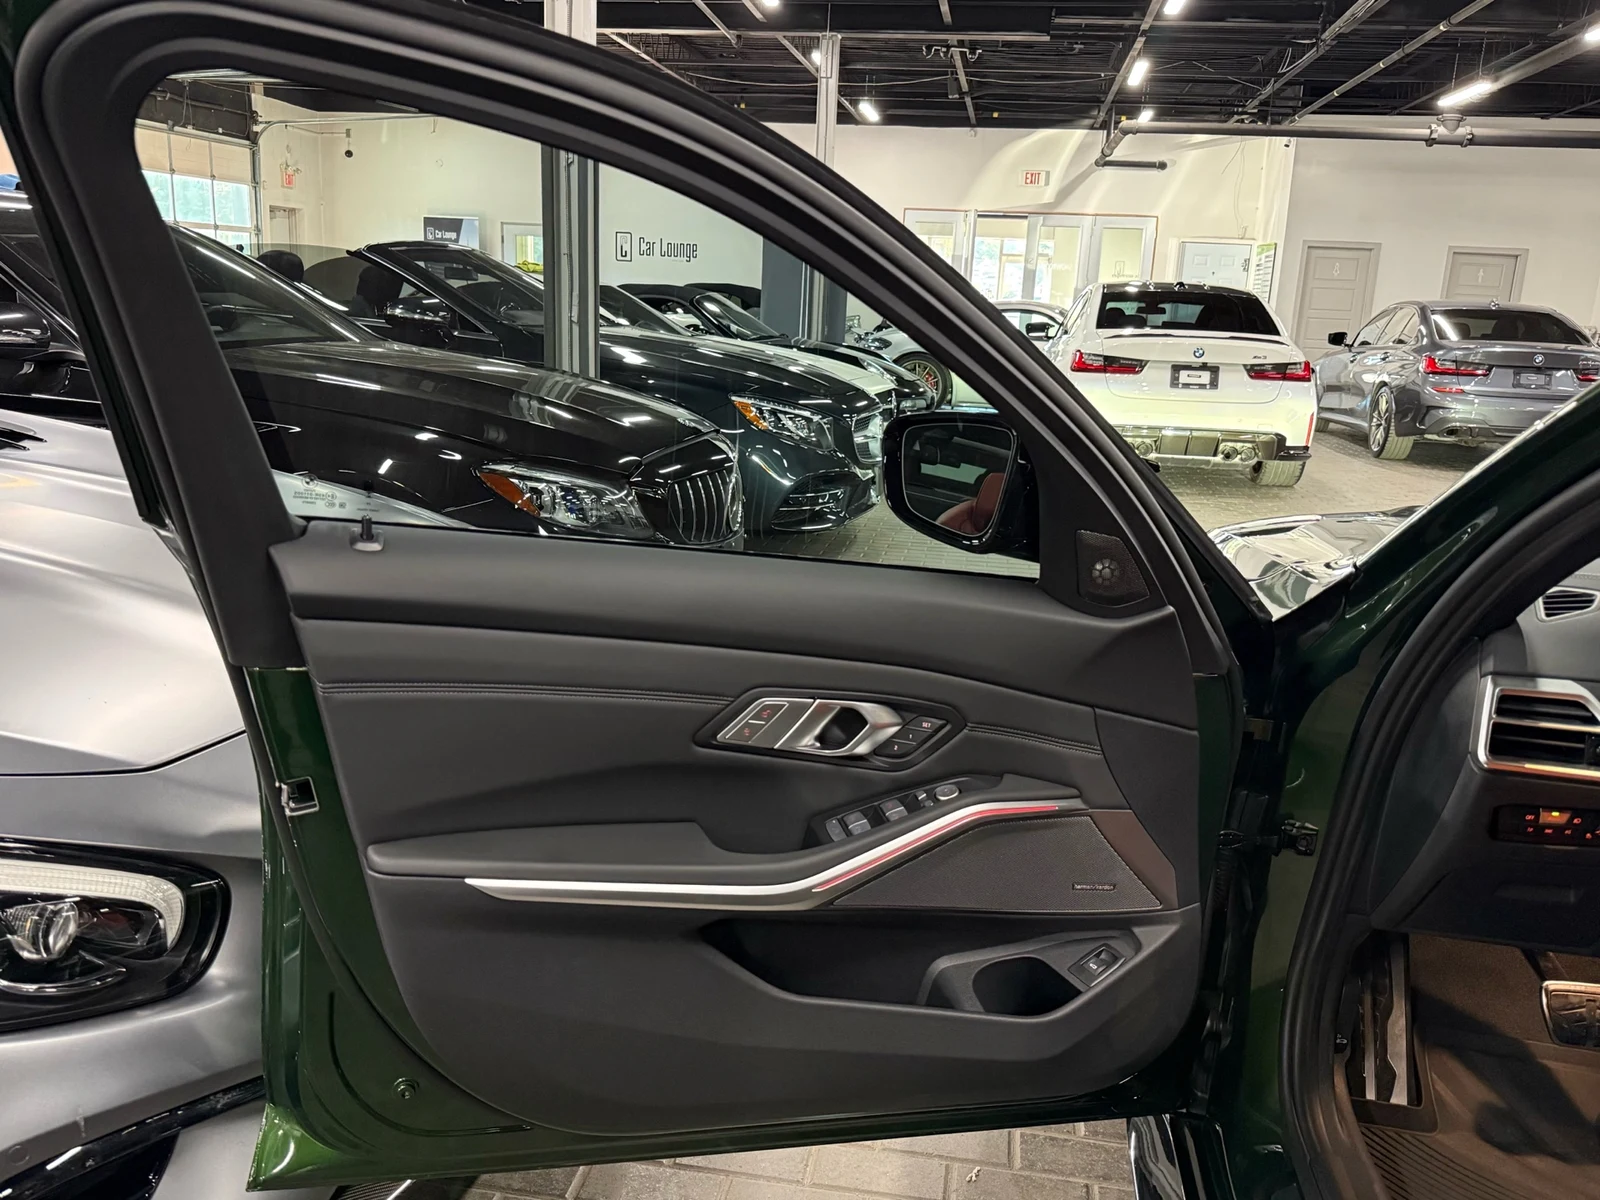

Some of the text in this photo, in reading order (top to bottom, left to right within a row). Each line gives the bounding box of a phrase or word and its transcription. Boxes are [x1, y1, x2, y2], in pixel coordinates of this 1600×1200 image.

[1024, 172, 1041, 185] EXIT
[638, 236, 698, 263] Car Lounge
